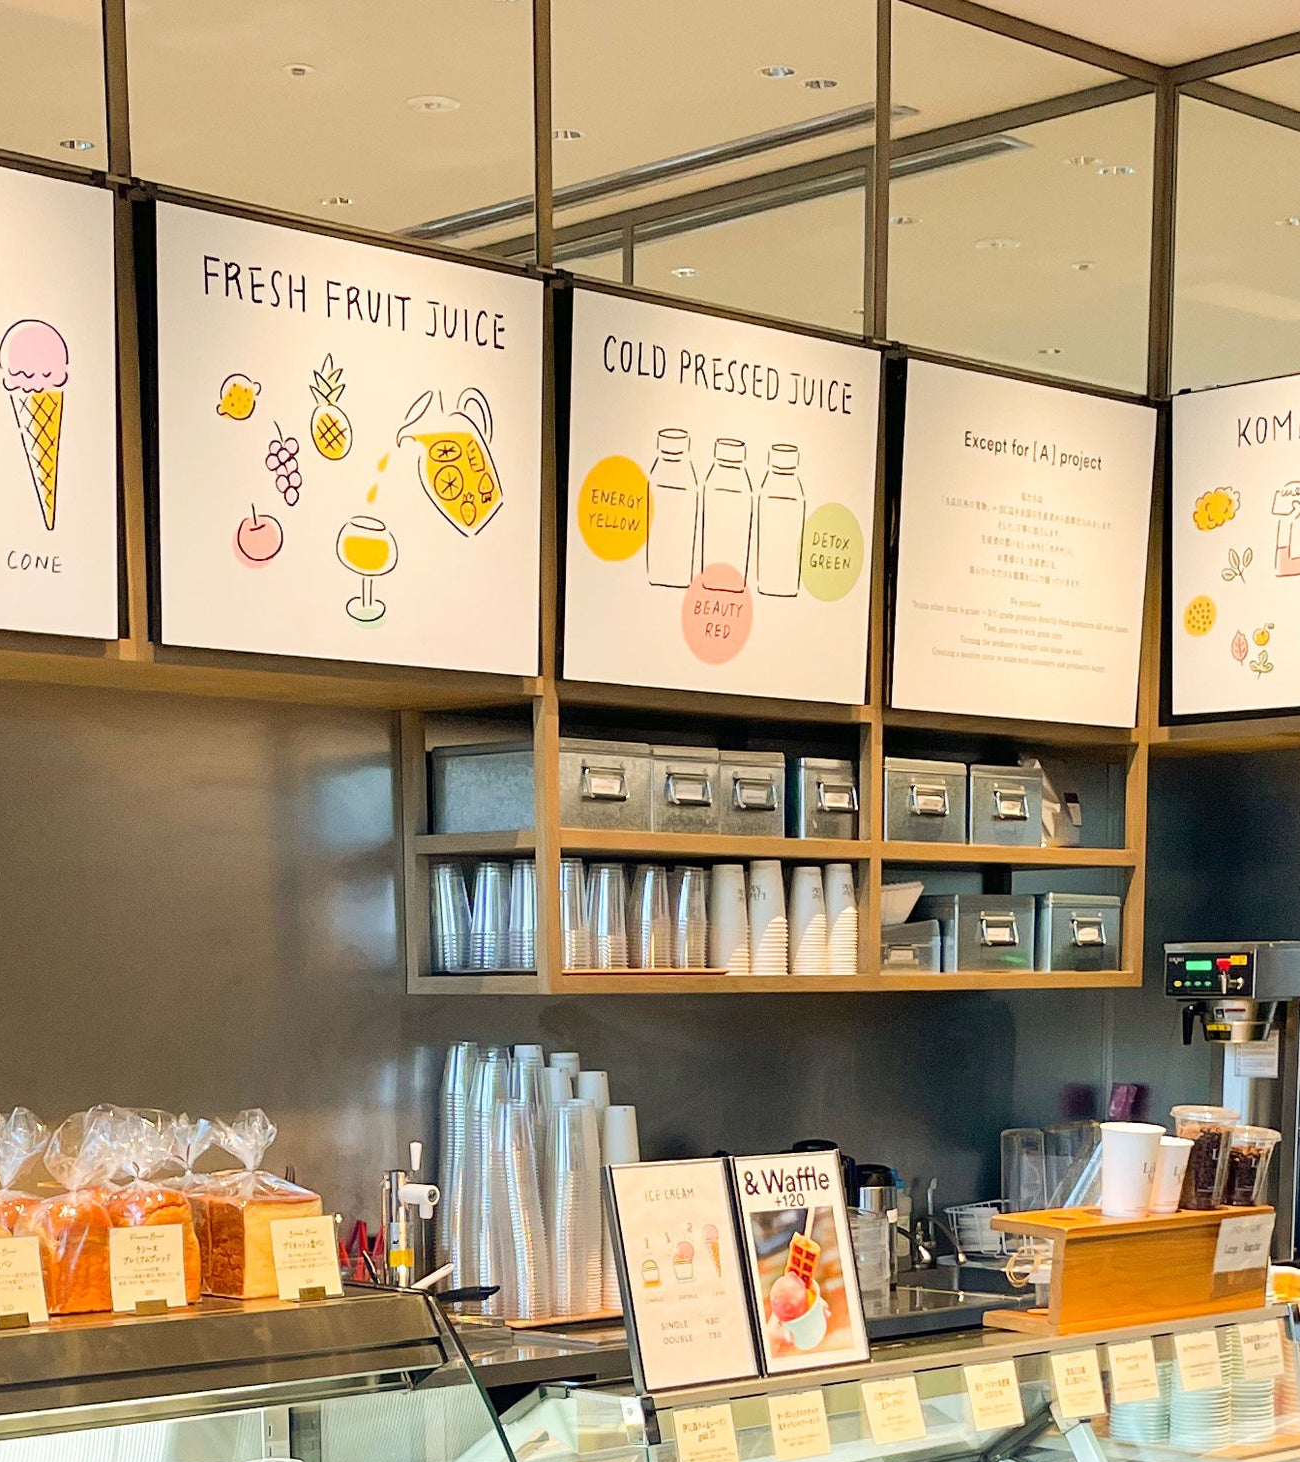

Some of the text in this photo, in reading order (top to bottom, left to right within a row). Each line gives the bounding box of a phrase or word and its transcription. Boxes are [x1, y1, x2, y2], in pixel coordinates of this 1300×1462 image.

[203, 255, 507, 351] FRESH FRUIT JUICE
[603, 334, 852, 416] COLD PRESSED JUICE
[964, 430, 1007, 456] Except
[1011, 438, 1029, 457] for
[1059, 451, 1102, 471] project
[591, 488, 644, 510] ENERGY
[588, 513, 641, 532] YELLOW
[812, 531, 850, 550] DETOX
[7, 550, 63, 574] CONE
[809, 553, 851, 570] GREEN
[693, 600, 744, 618] BEAUTY
[705, 622, 730, 640] RED
[743, 1166, 830, 1196] & Waffle
[644, 1188, 694, 1202] ICE CREAM
[775, 1193, 805, 1208] +120
[660, 1320, 689, 1331] SINGLE
[663, 1334, 693, 1345] DOUBLE
